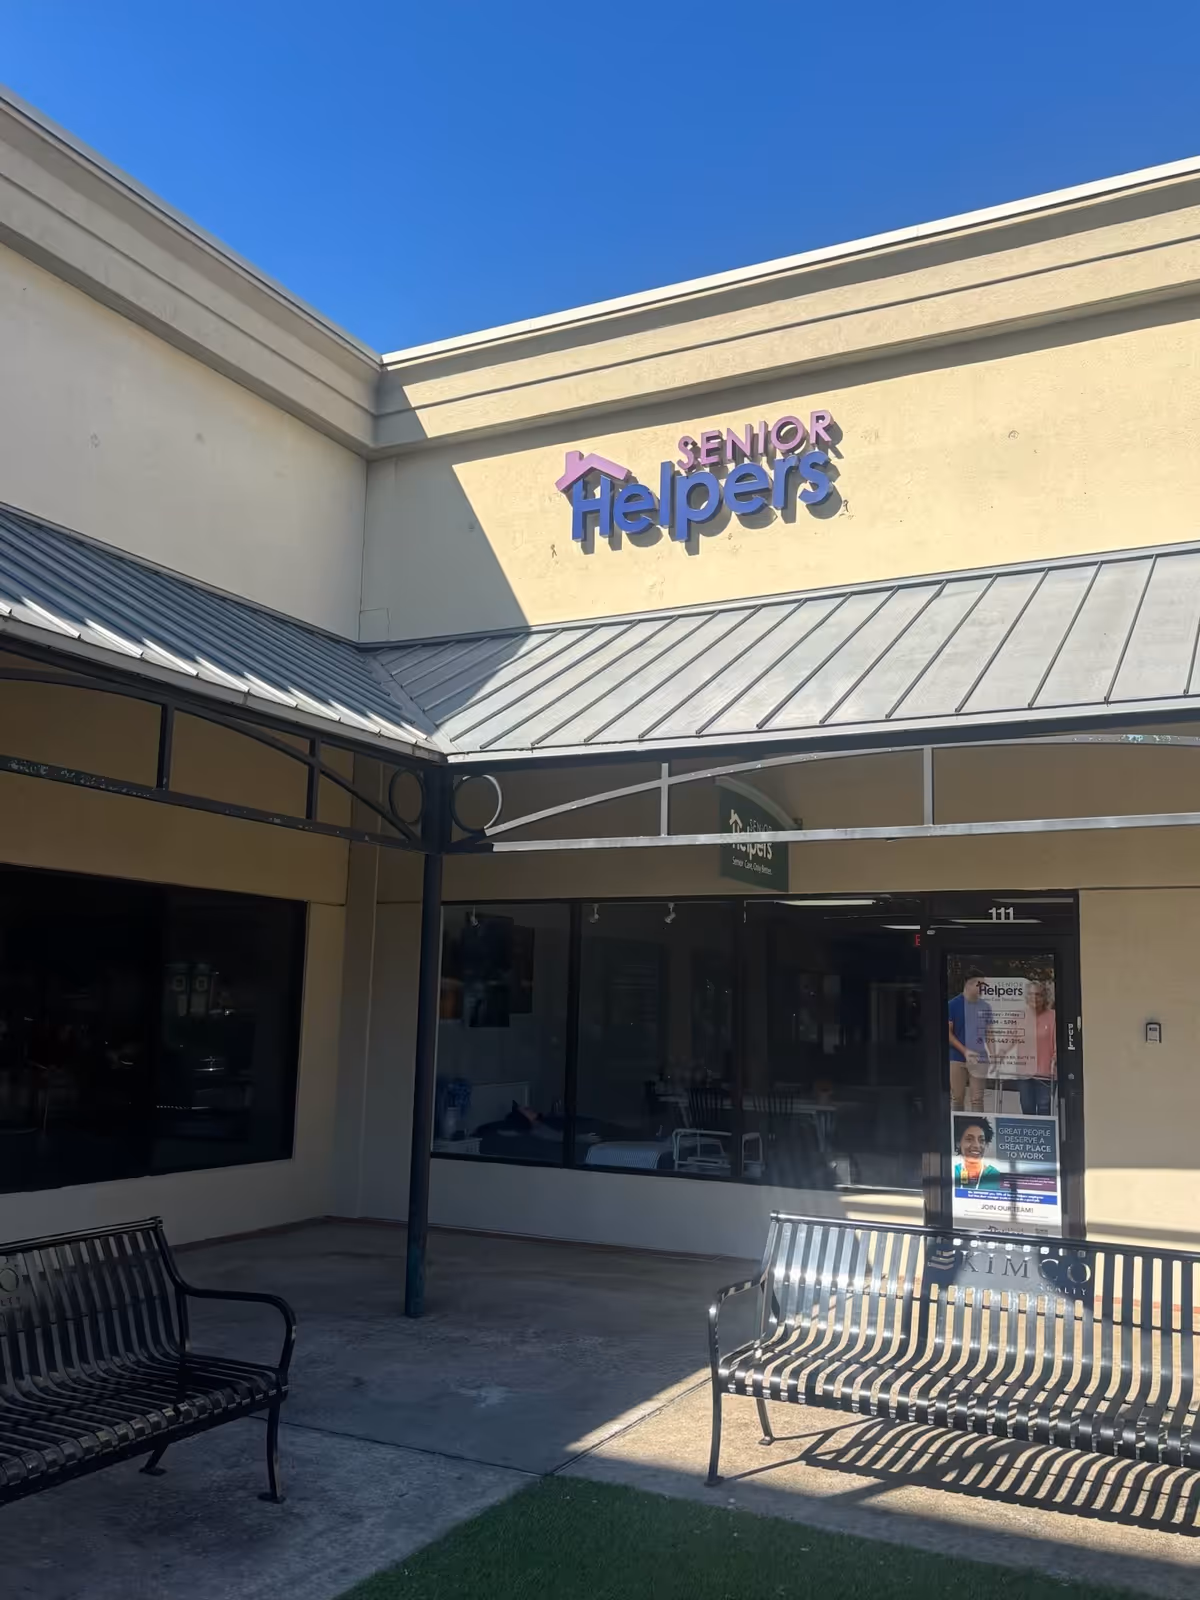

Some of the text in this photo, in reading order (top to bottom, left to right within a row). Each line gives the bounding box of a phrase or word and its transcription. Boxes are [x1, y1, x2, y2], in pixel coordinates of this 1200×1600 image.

[676, 409, 833, 471] SENIOR
[571, 450, 833, 542] Helpers
[988, 907, 1014, 921] 111
[979, 985, 1024, 998] Helpers
[999, 1127, 1051, 1137] GREAT PEOPLE
[998, 1143, 1051, 1152] GREAT PLACE
[1019, 1152, 1044, 1160] WORK
[962, 1251, 1091, 1283] KIMCO
